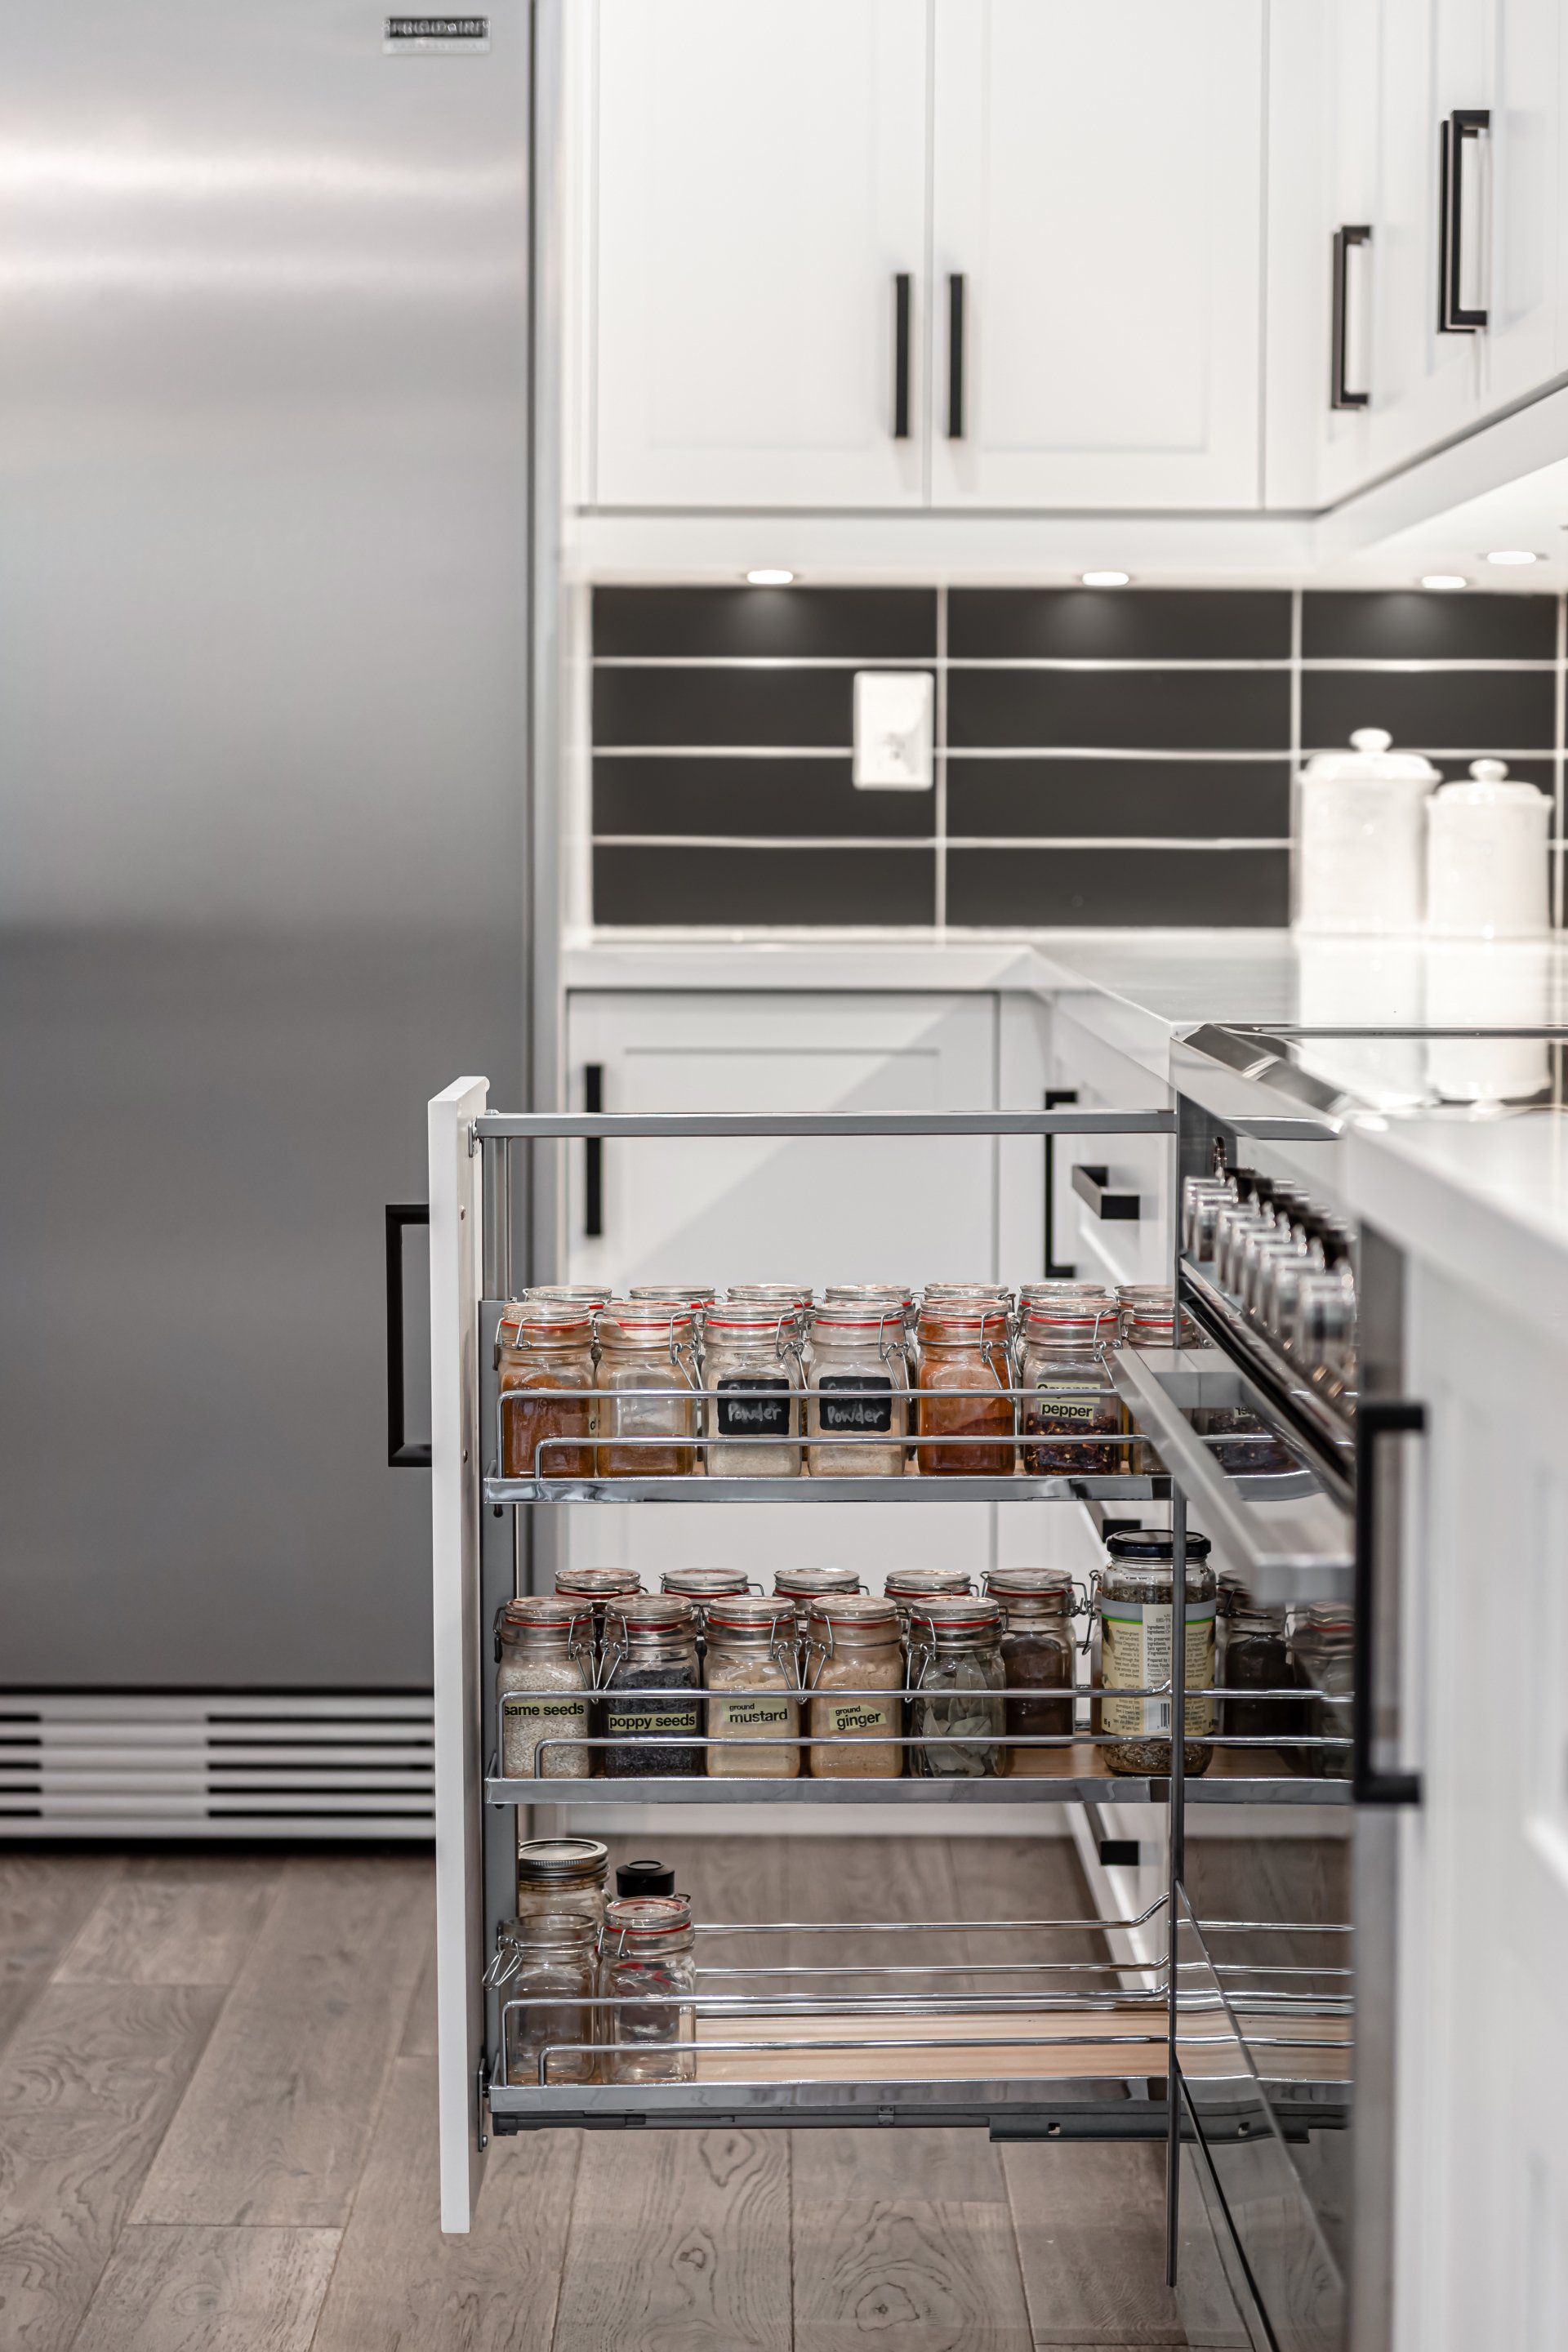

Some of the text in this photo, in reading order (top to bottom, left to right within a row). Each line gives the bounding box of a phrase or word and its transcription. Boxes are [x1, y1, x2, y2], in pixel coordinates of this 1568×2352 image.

[728, 1401, 782, 1422] Powder
[827, 1403, 884, 1424] Powder
[1041, 1404, 1093, 1418] pepper
[543, 1703, 585, 1716] seeds
[729, 1704, 755, 1712] ground
[729, 1708, 788, 1723] mustard
[835, 1705, 862, 1716] ground
[609, 1714, 695, 1730] poppy seeds
[836, 1712, 881, 1731] ginger
